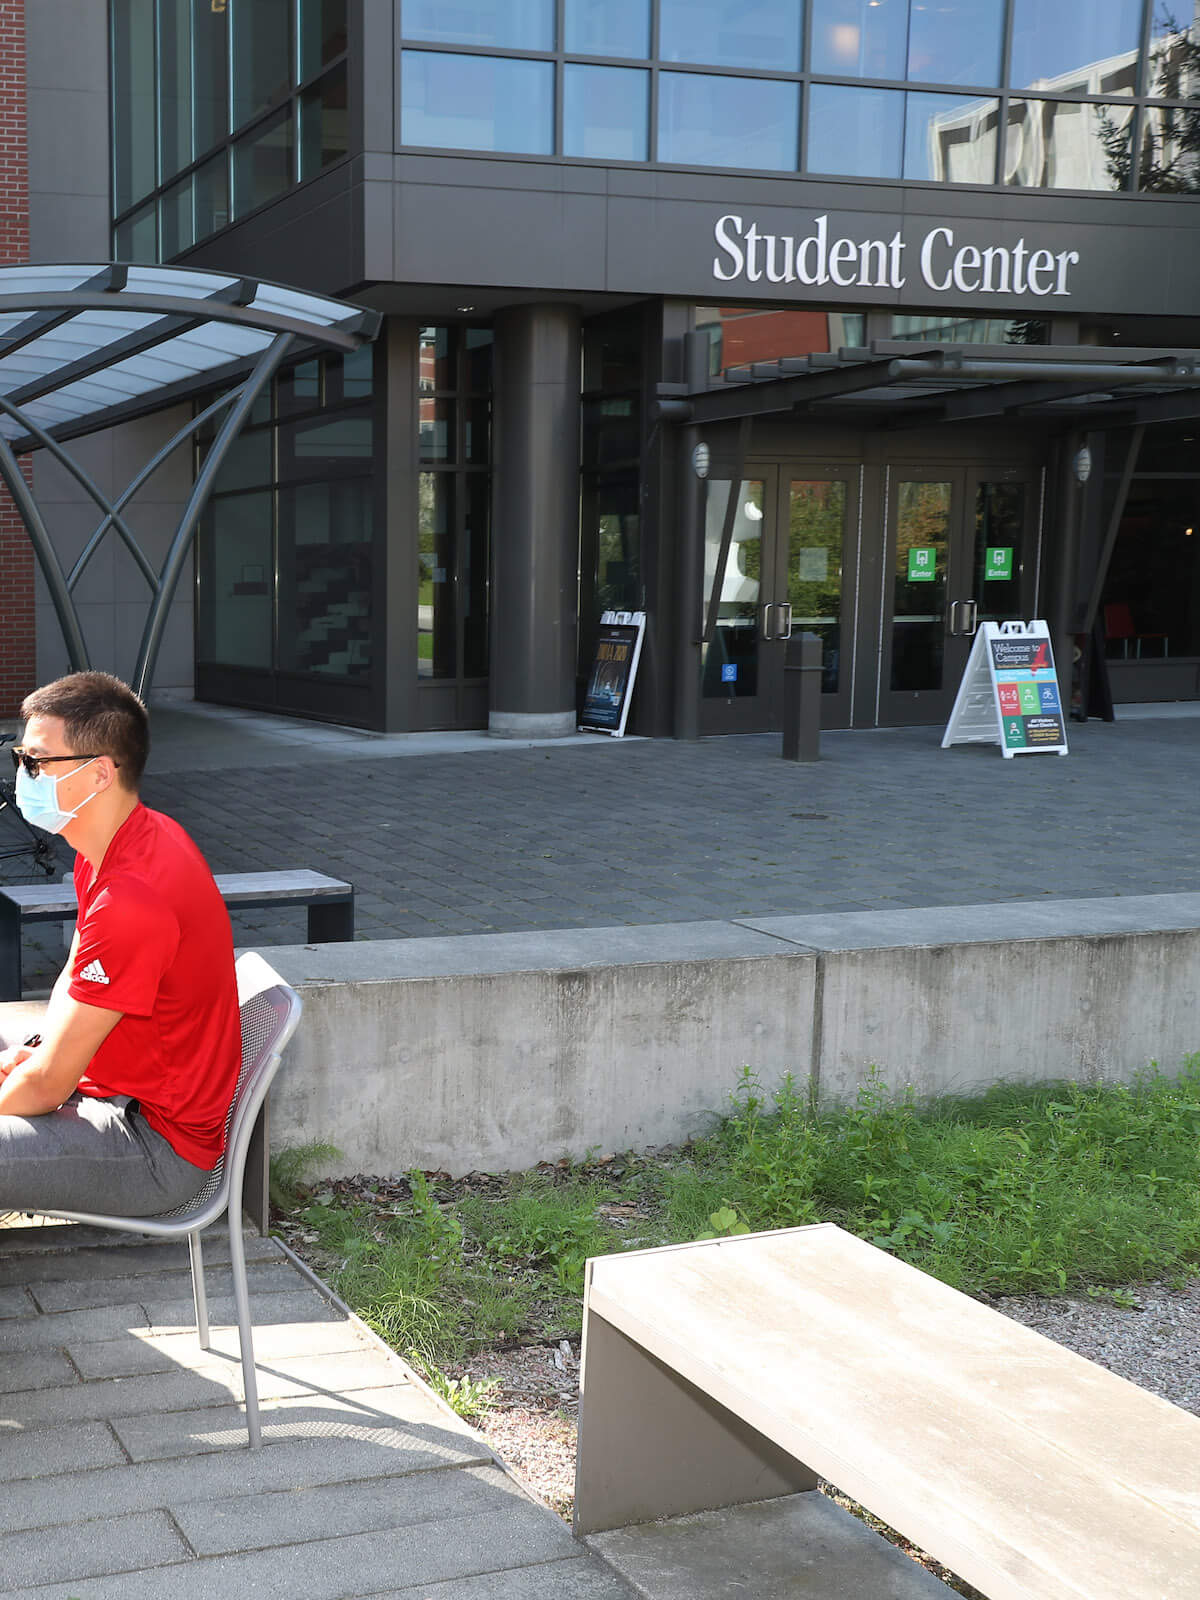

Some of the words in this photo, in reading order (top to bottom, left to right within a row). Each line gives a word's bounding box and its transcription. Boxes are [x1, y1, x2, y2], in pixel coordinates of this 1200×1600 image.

[712, 214, 906, 289] Student
[920, 227, 1080, 296] Center
[993, 643, 1031, 652] Welcome
[1031, 643, 1040, 652] to
[996, 653, 1029, 664] Campus
[79, 970, 110, 985] adidas
